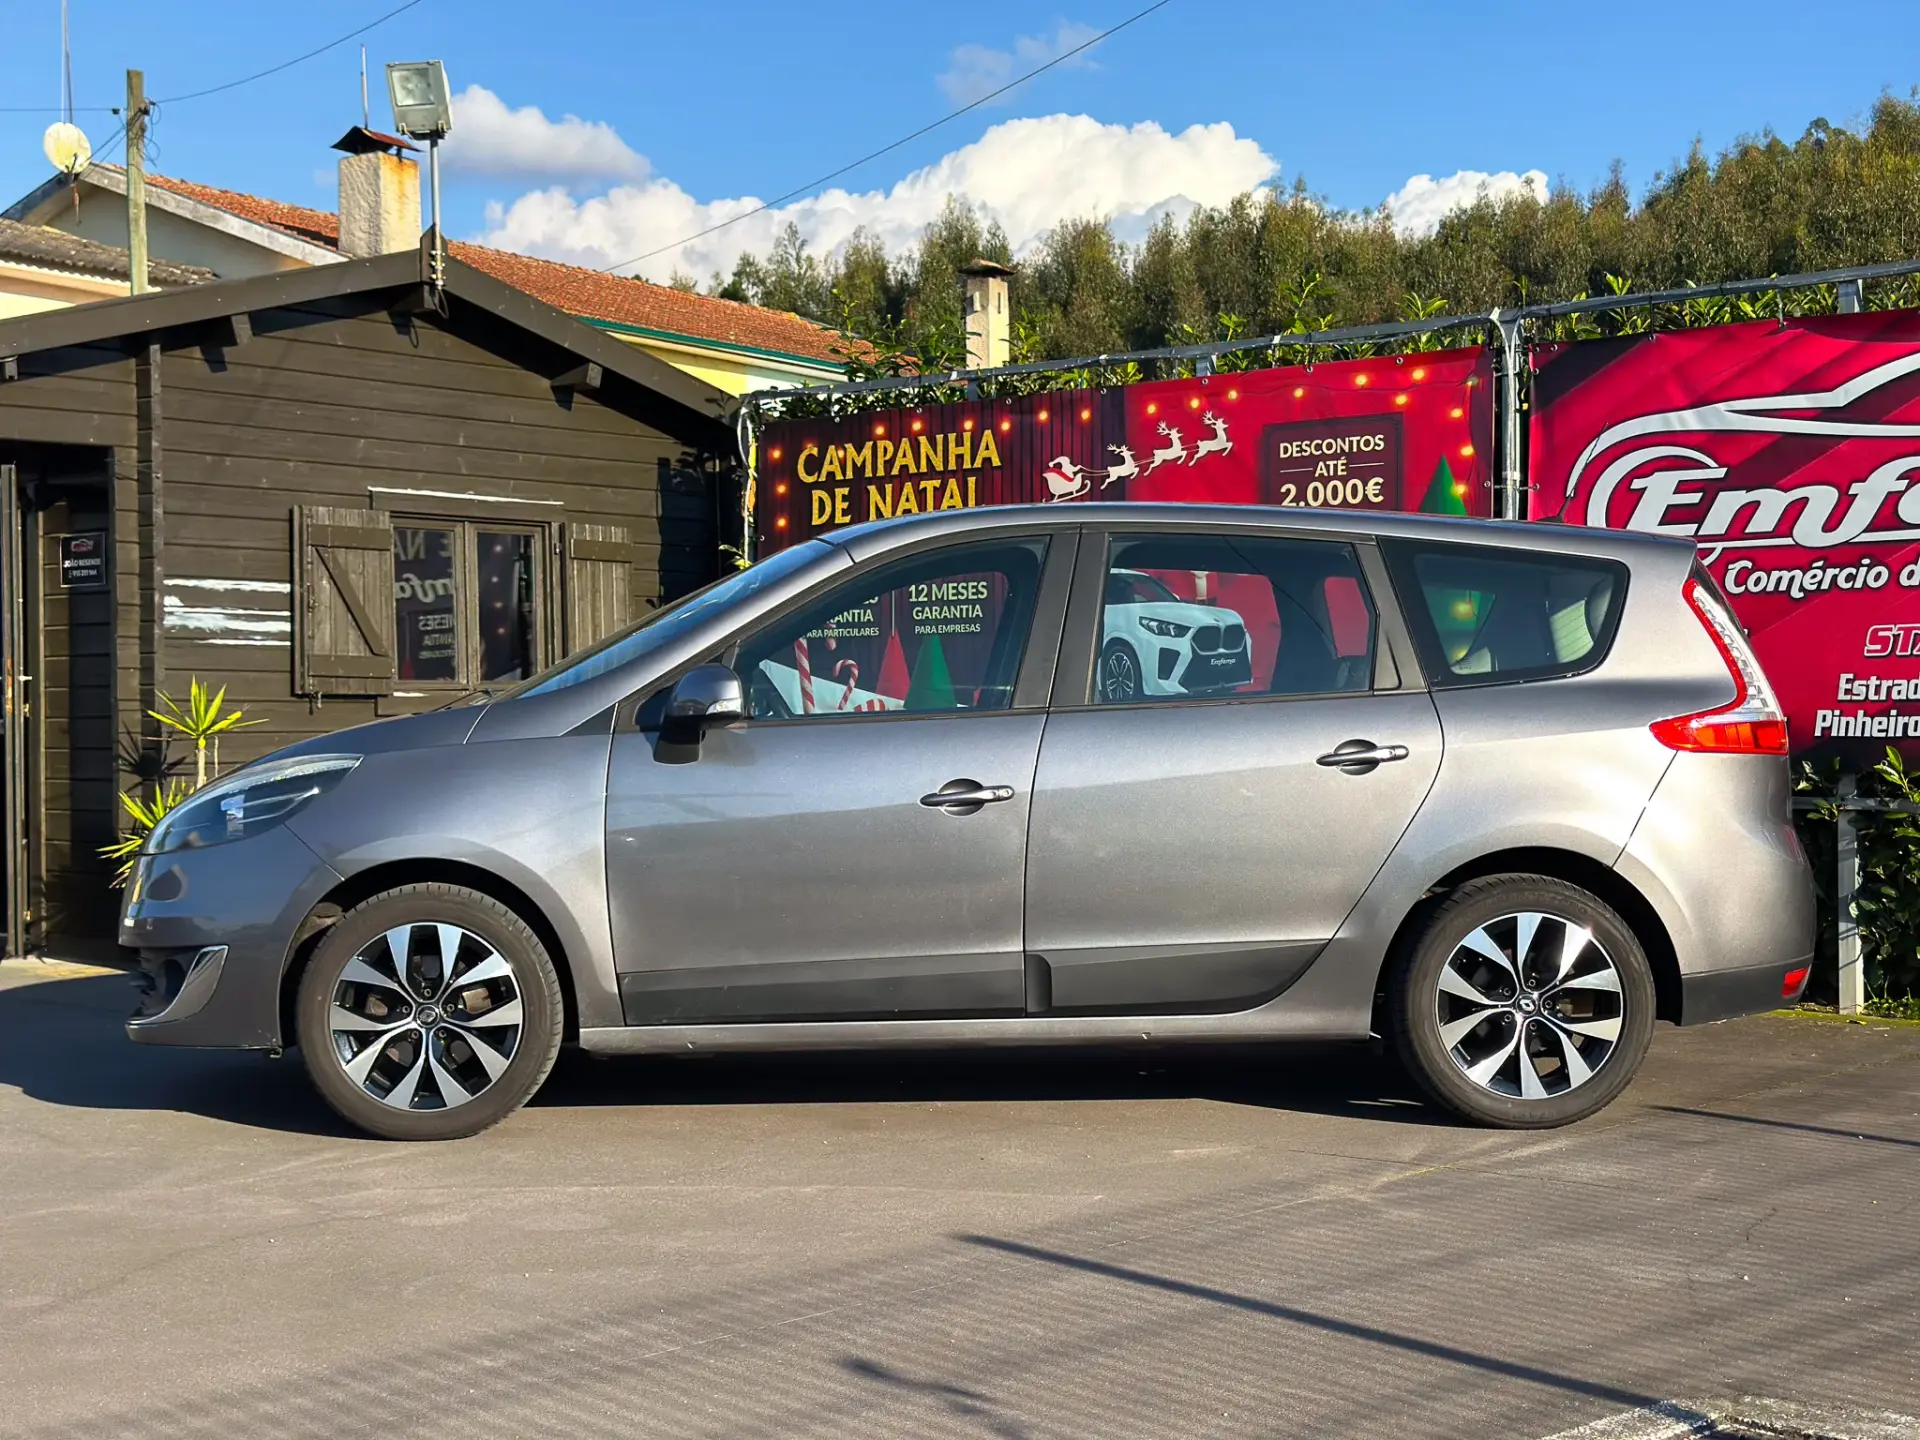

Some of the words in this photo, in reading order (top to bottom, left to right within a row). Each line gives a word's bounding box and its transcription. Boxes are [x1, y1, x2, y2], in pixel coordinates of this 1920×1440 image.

[797, 429, 1001, 483] CAMPANHA
[1280, 434, 1384, 458] DESCONTOS
[1315, 456, 1347, 477] ATÉ
[1280, 477, 1384, 507] 2.000€
[811, 487, 852, 526] DE
[1725, 559, 1889, 599] Comércio
[908, 584, 928, 602] 12
[931, 582, 988, 601] MESES
[827, 609, 874, 624] ANTIA
[912, 604, 983, 620] GARANTIA
[806, 629, 824, 638] ARA
[823, 627, 880, 638] PARTICULARES
[915, 625, 937, 635] PARA
[938, 623, 981, 634] EMPRESAS
